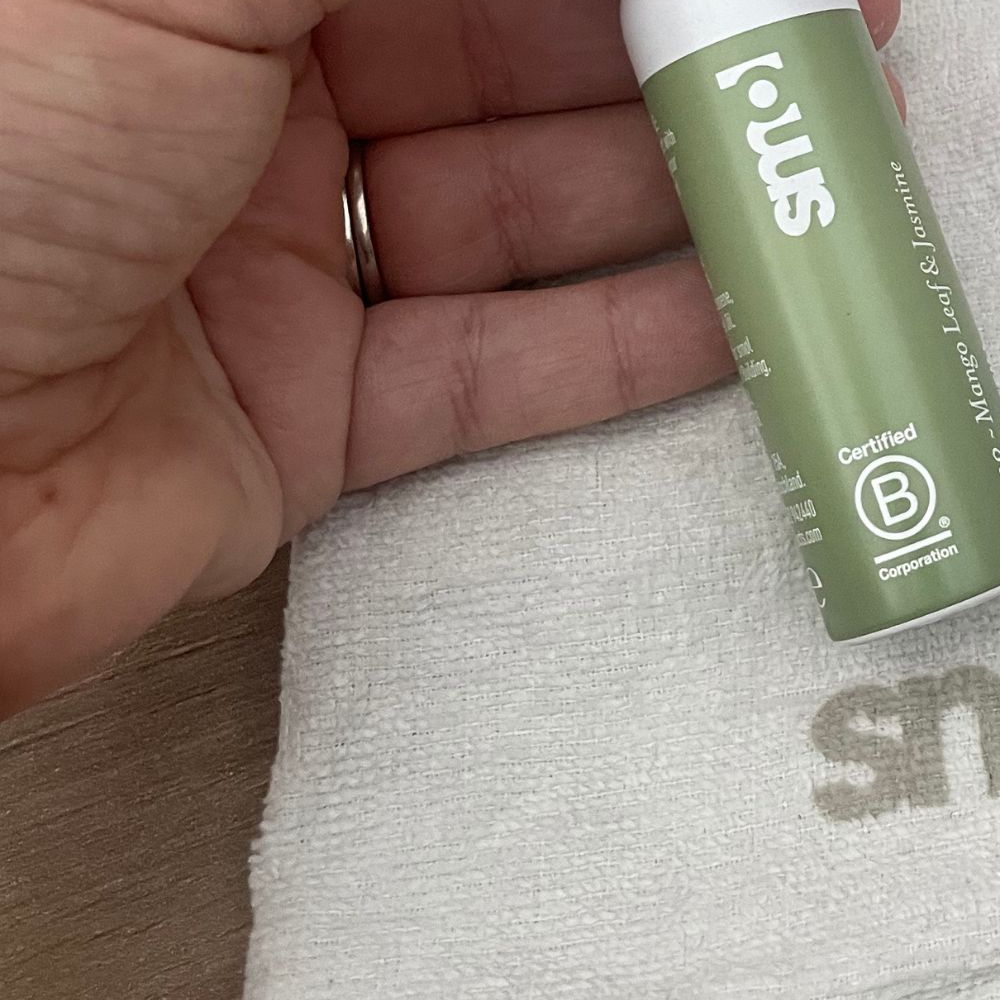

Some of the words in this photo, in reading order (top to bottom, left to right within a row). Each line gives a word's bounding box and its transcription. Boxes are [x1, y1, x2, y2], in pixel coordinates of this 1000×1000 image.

[715, 51, 836, 237] smol
[890, 161, 936, 252] Jasmine
[920, 255, 939, 276] &
[926, 279, 961, 334] Leaf
[956, 341, 994, 424] Mango
[838, 422, 918, 465] Certified
[878, 544, 960, 581] Corporation
